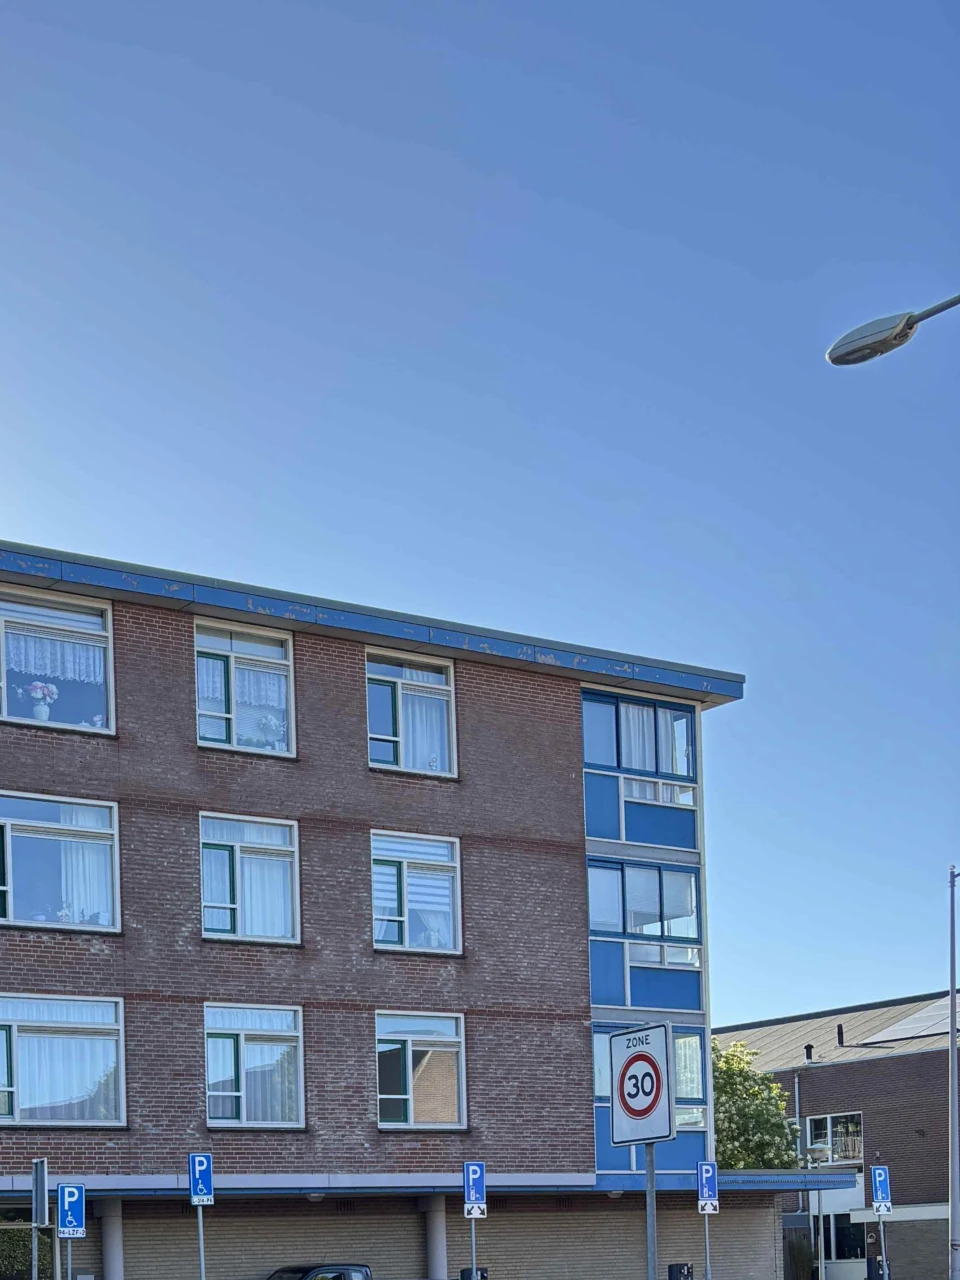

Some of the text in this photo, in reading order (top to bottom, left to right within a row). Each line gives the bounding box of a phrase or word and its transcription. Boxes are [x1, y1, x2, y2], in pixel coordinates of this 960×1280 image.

[626, 1034, 651, 1049] ZONE
[626, 1072, 655, 1099] 30
[195, 1157, 207, 1178] P
[469, 1165, 480, 1186] P
[702, 1165, 713, 1184] P
[875, 1169, 885, 1187] P
[64, 1187, 79, 1210] P
